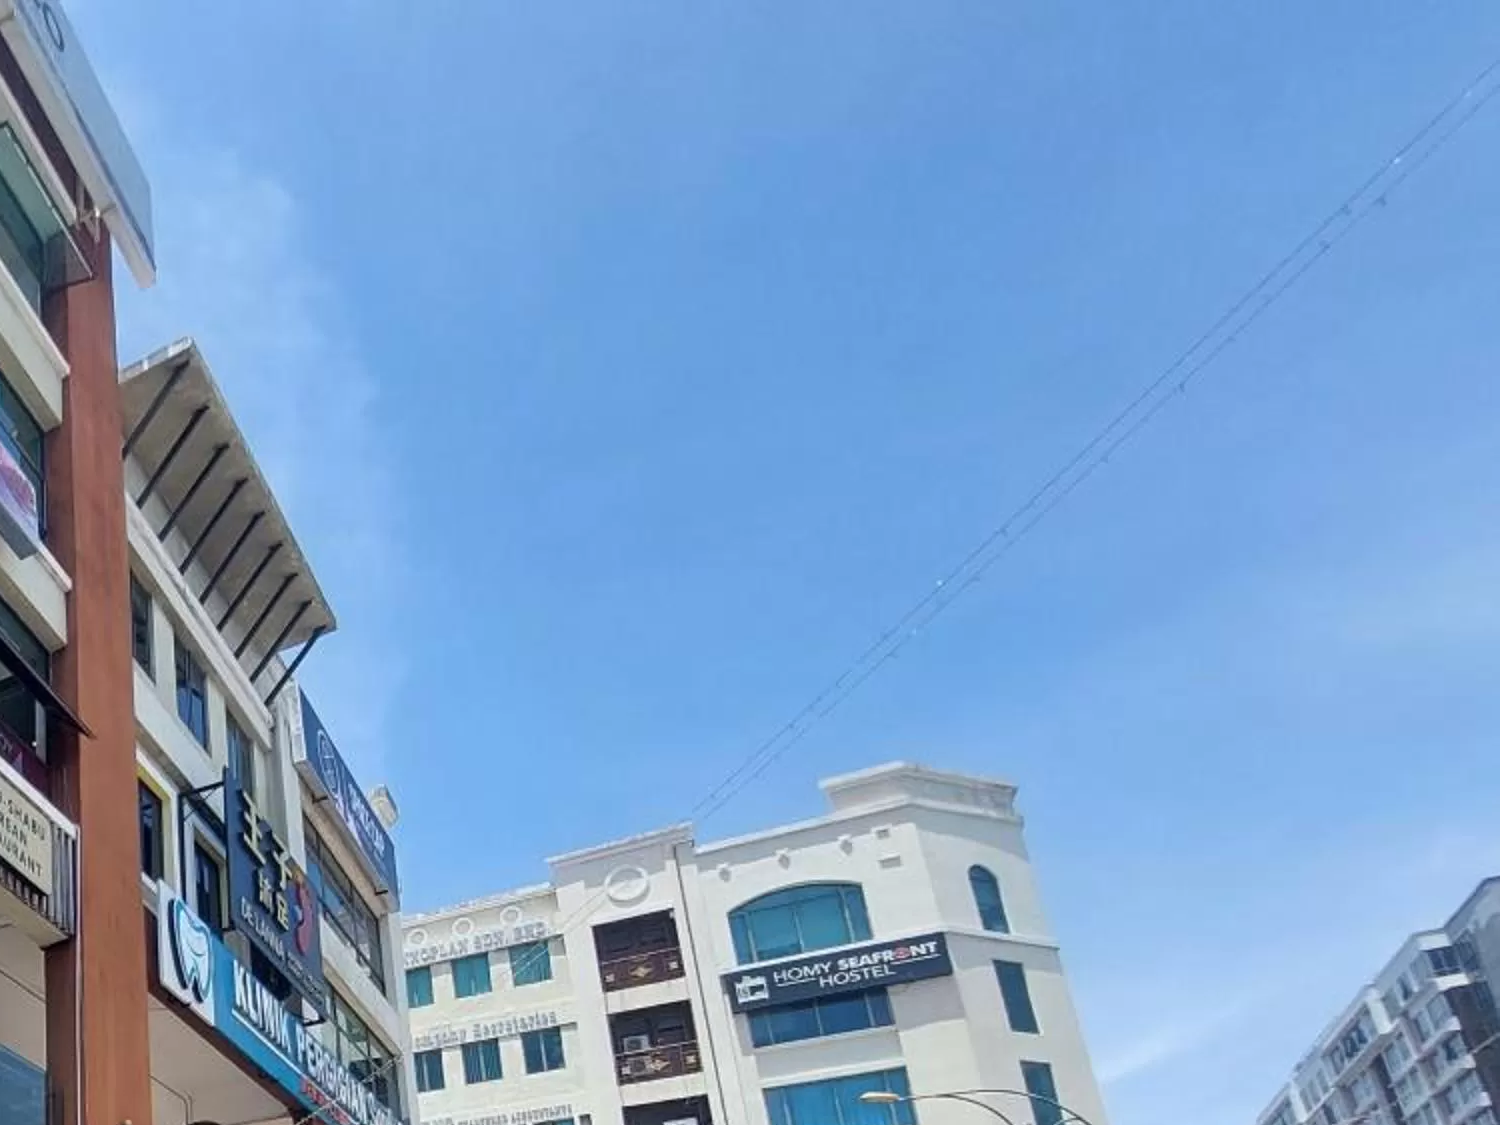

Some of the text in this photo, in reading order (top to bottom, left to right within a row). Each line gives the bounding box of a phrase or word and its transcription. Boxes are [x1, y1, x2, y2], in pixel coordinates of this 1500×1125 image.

[772, 941, 939, 983] HOMY SEAFRONT
[818, 964, 898, 989] HOSTEL
[231, 958, 293, 1058] KLINIK
